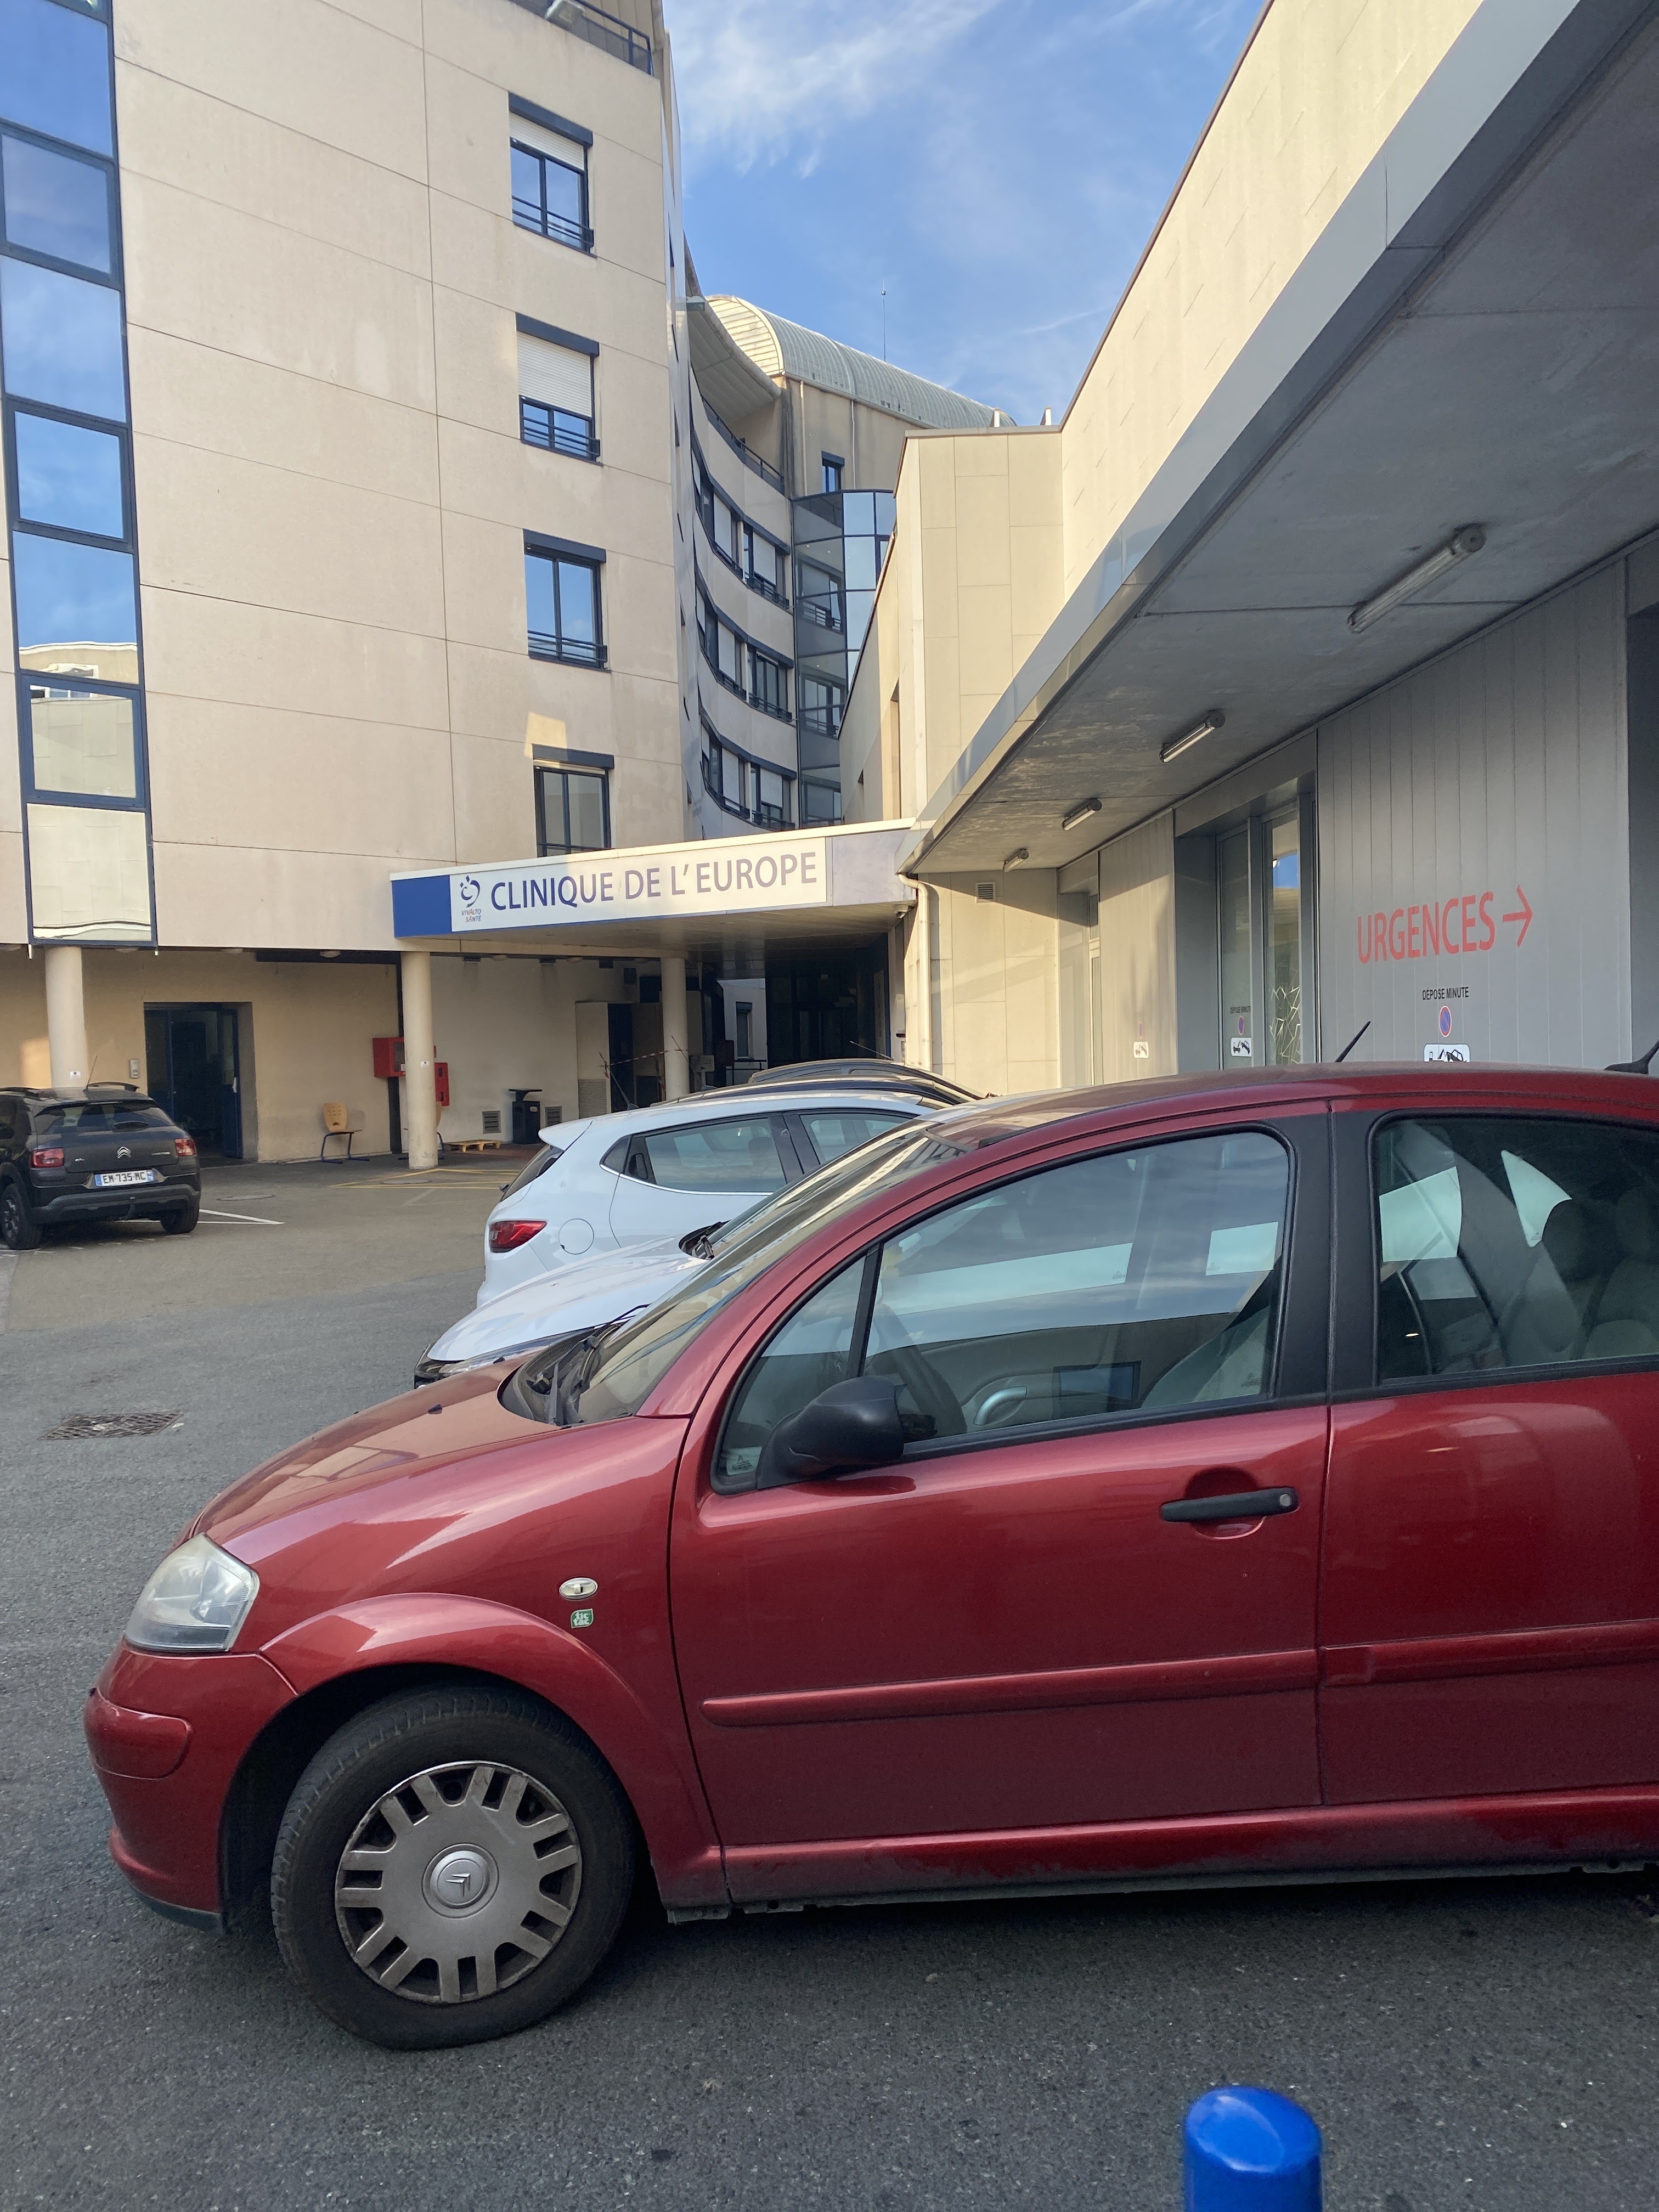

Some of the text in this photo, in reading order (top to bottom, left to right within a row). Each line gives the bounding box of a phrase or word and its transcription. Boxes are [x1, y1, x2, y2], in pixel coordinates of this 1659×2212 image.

[491, 851, 817, 910] CLINIQUE DE L'EUROPE
[1357, 891, 1496, 963] URGENCES
[1446, 986, 1469, 998] MINUTE
[573, 1618, 590, 1626] tac
